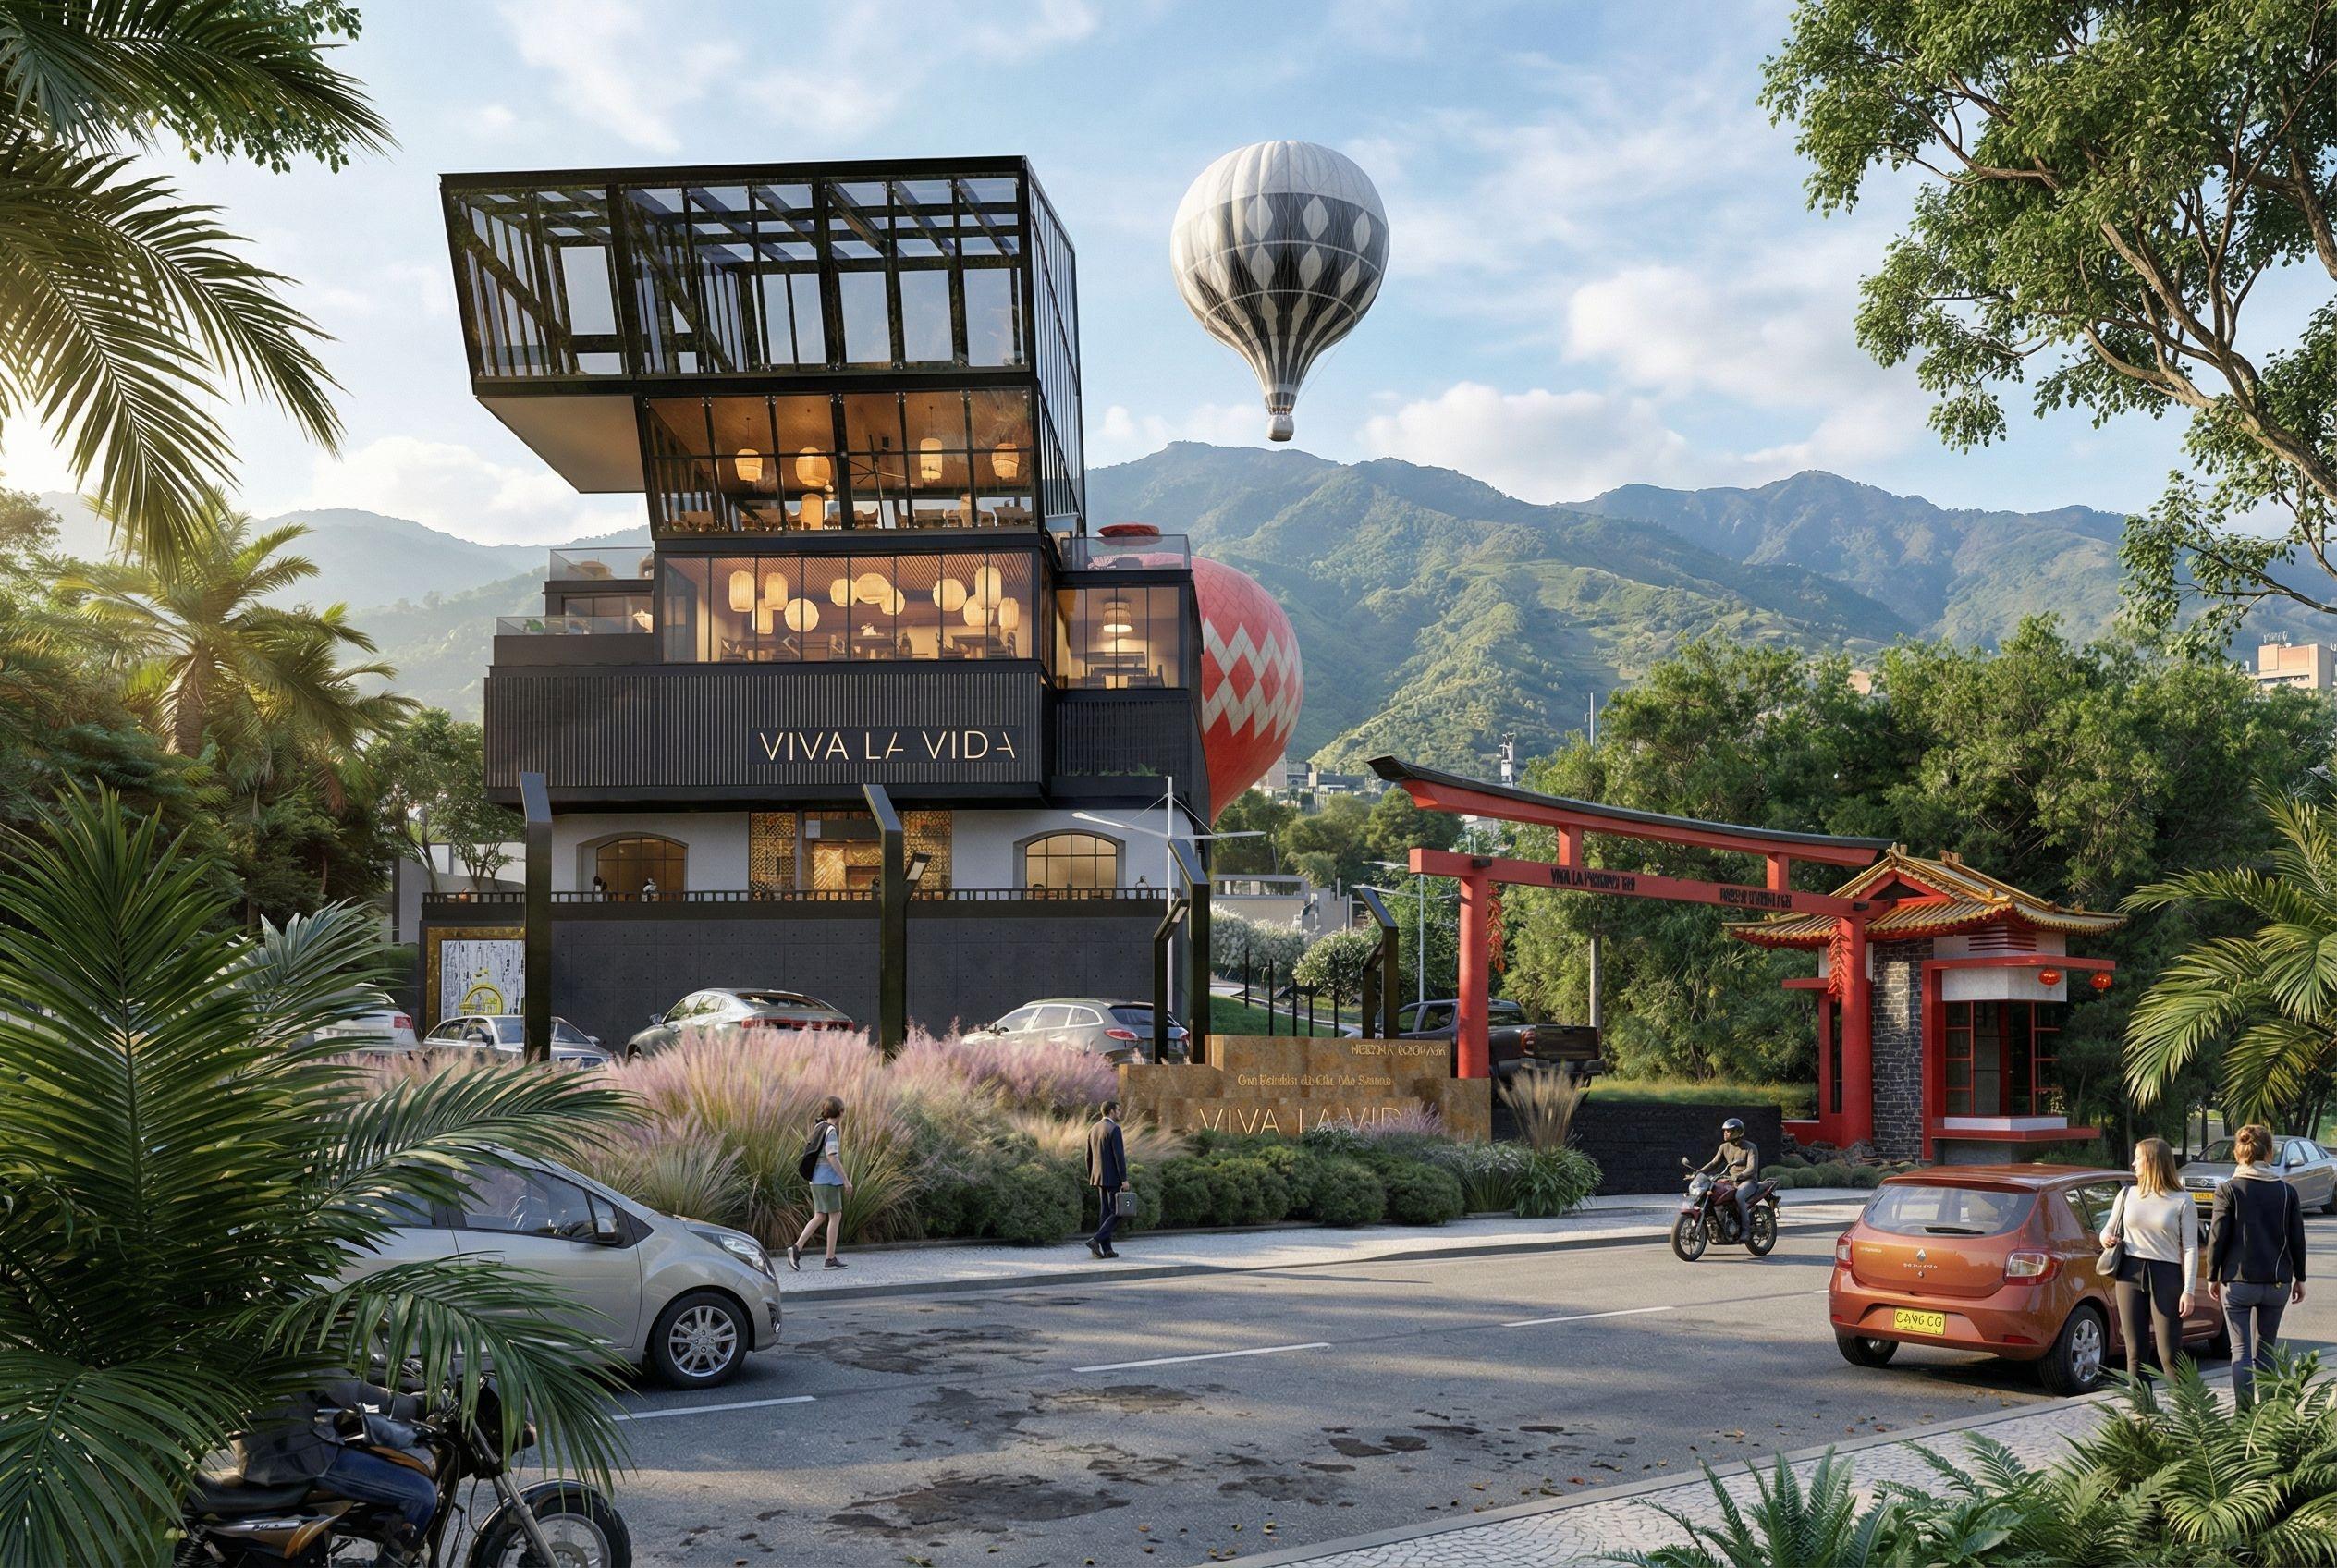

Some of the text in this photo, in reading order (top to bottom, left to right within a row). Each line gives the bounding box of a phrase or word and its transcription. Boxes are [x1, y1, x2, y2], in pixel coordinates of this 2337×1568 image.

[760, 730, 1015, 761] VIVA LA VIDA
[1199, 1108, 1281, 1136] VIVA
